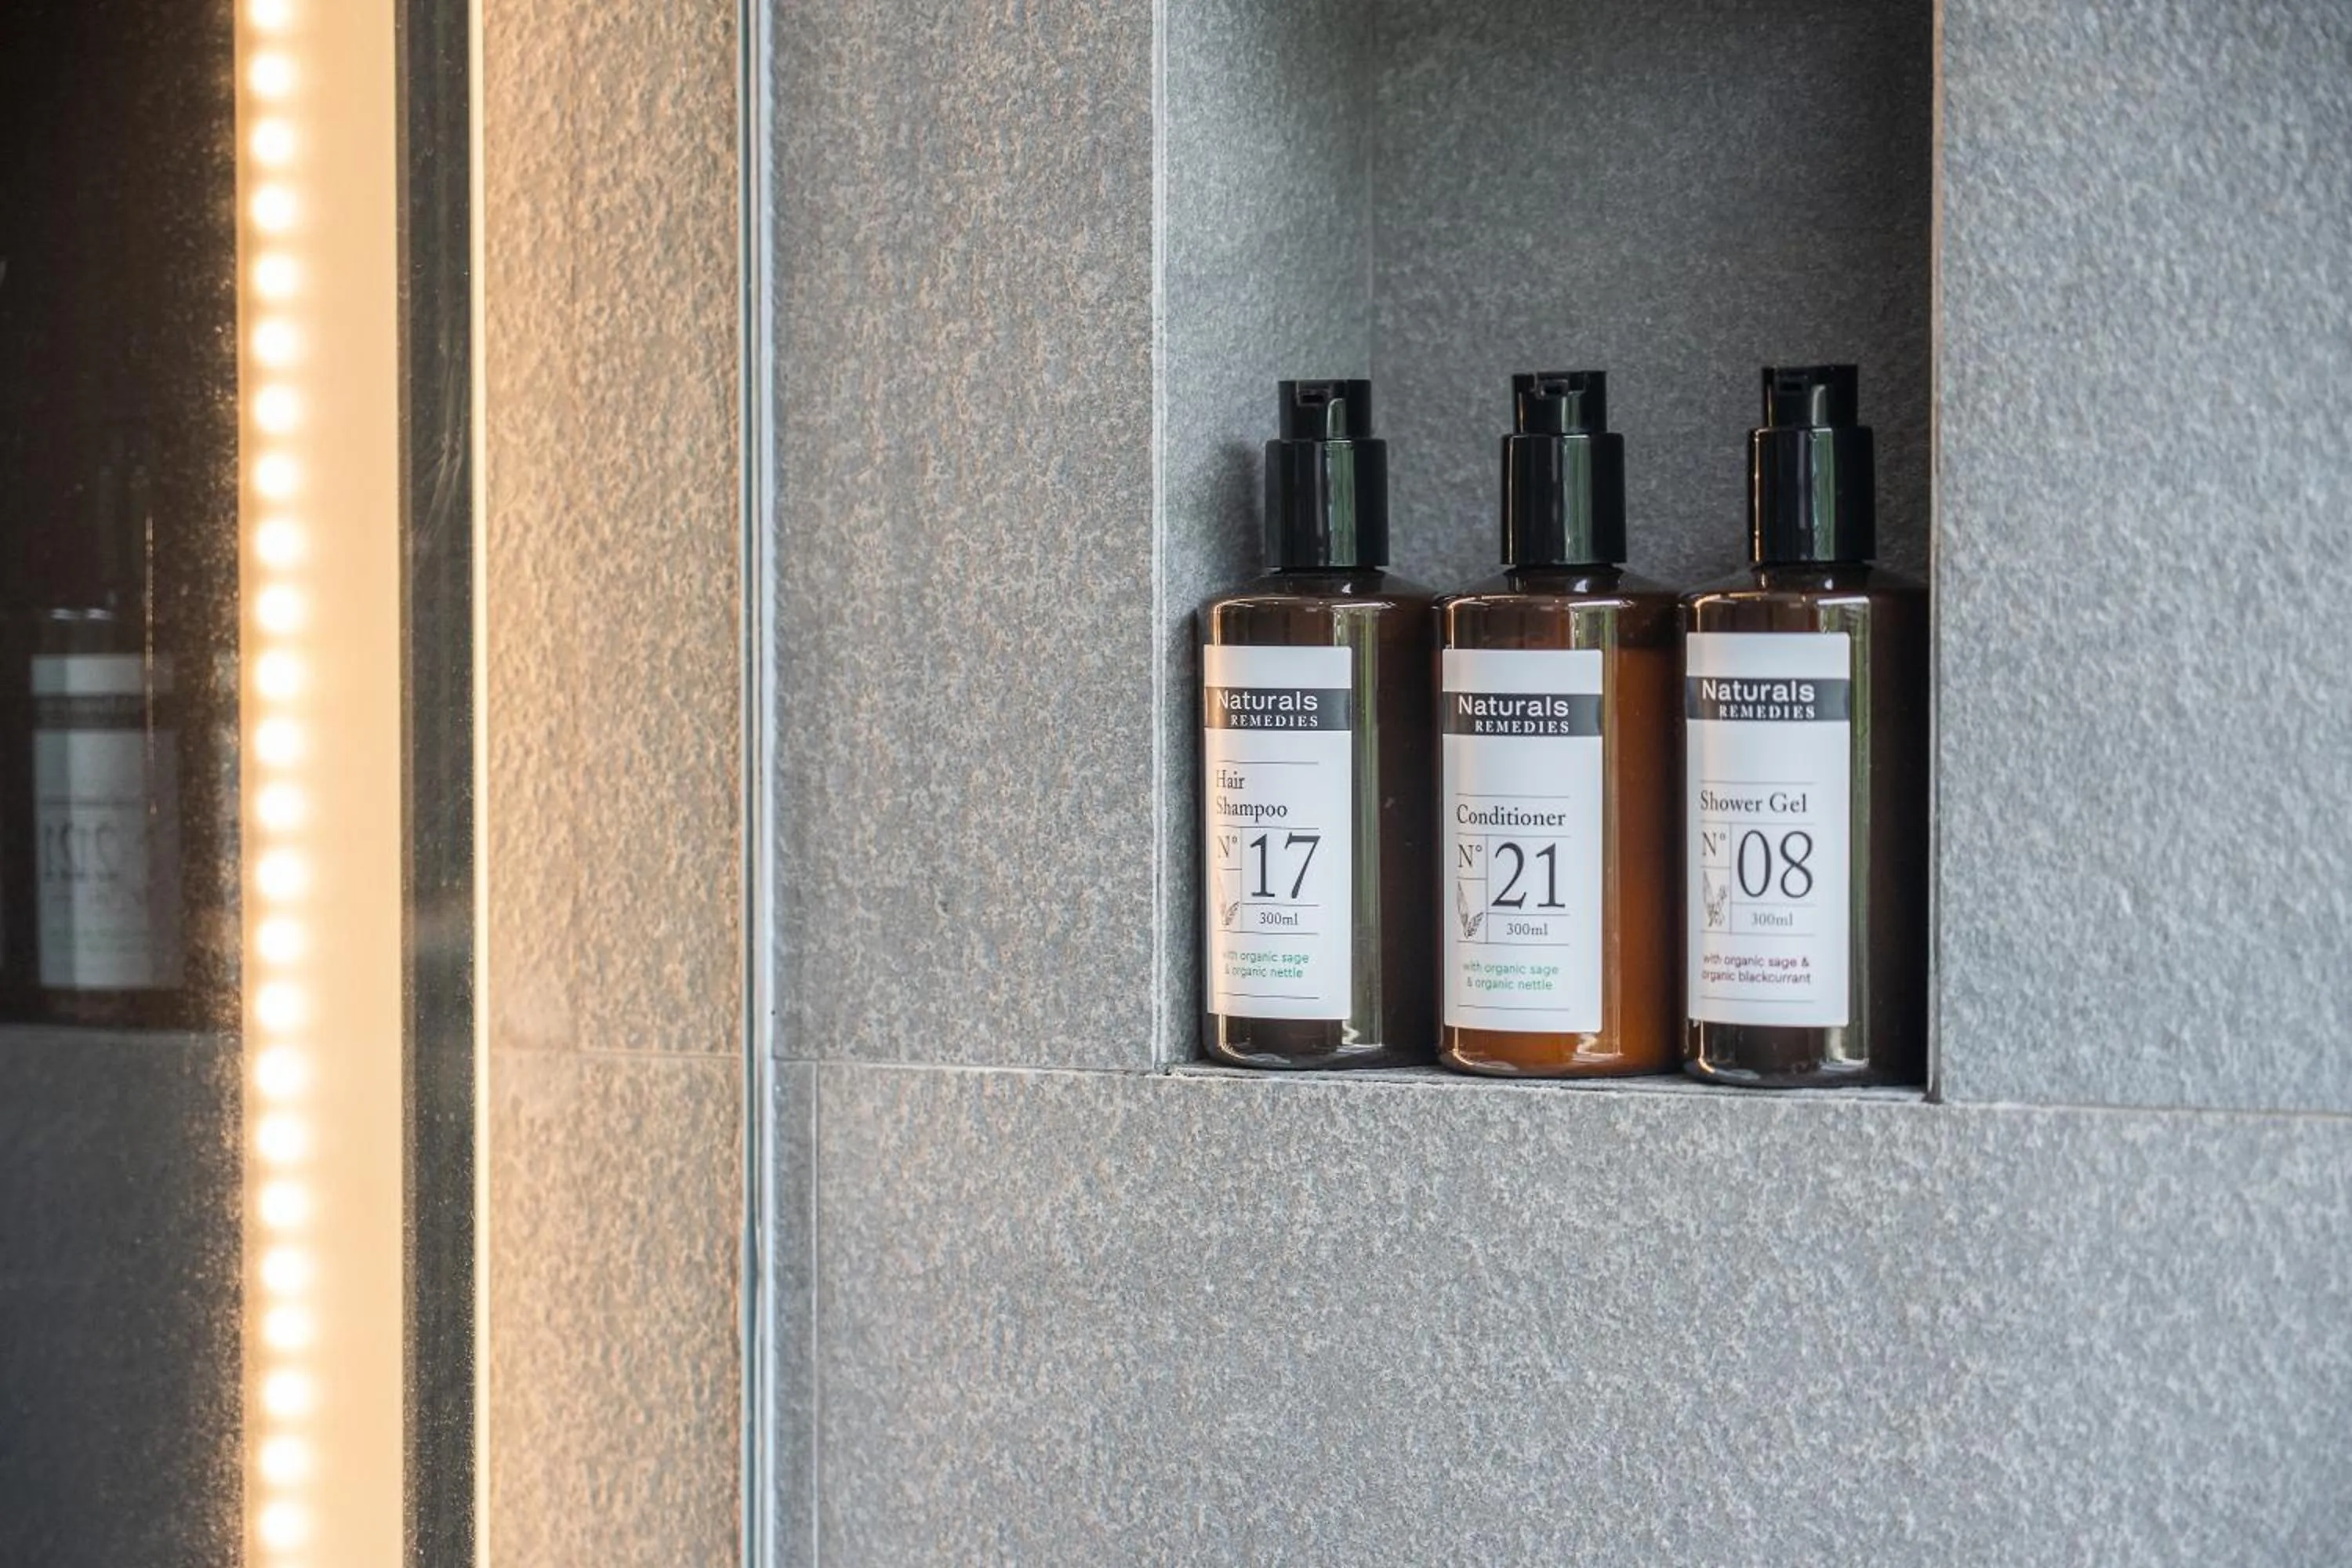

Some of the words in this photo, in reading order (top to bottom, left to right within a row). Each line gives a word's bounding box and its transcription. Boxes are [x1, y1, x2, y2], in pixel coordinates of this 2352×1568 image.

[1702, 679, 1815, 702] Naturals
[1216, 689, 1318, 710] Naturals
[1458, 695, 1569, 717] Naturals
[1719, 705, 1816, 719] REMEDIES
[1230, 714, 1318, 728] REMEDIES
[1475, 720, 1569, 733] REMEDIES
[1216, 769, 1245, 789] Hair
[1216, 796, 1288, 823] Shampoo
[1700, 790, 1762, 812] Shower
[1769, 792, 1806, 813] Gel
[1457, 804, 1566, 826] Conditioner
[1250, 832, 1321, 898] 17
[1737, 829, 1813, 898] 08
[1491, 842, 1566, 909] 21
[1260, 913, 1298, 925] 300ml
[1751, 912, 1793, 926] 300ml
[1506, 923, 1548, 935] 300ml
[1240, 951, 1278, 963] organic
[1281, 953, 1309, 964] sage
[1704, 953, 1722, 964] with
[1724, 955, 1764, 967] organic
[1768, 958, 1798, 970] sage
[1801, 956, 1809, 967] &
[1232, 965, 1267, 978] organic
[1270, 967, 1303, 978] nettle
[1463, 960, 1482, 971] with
[1484, 963, 1526, 976] organic
[1530, 965, 1559, 977] sage
[1475, 978, 1514, 990] organic
[1518, 980, 1553, 990] nettle
[1701, 971, 1735, 982] organic
[1738, 971, 1811, 984] blackcurrant
